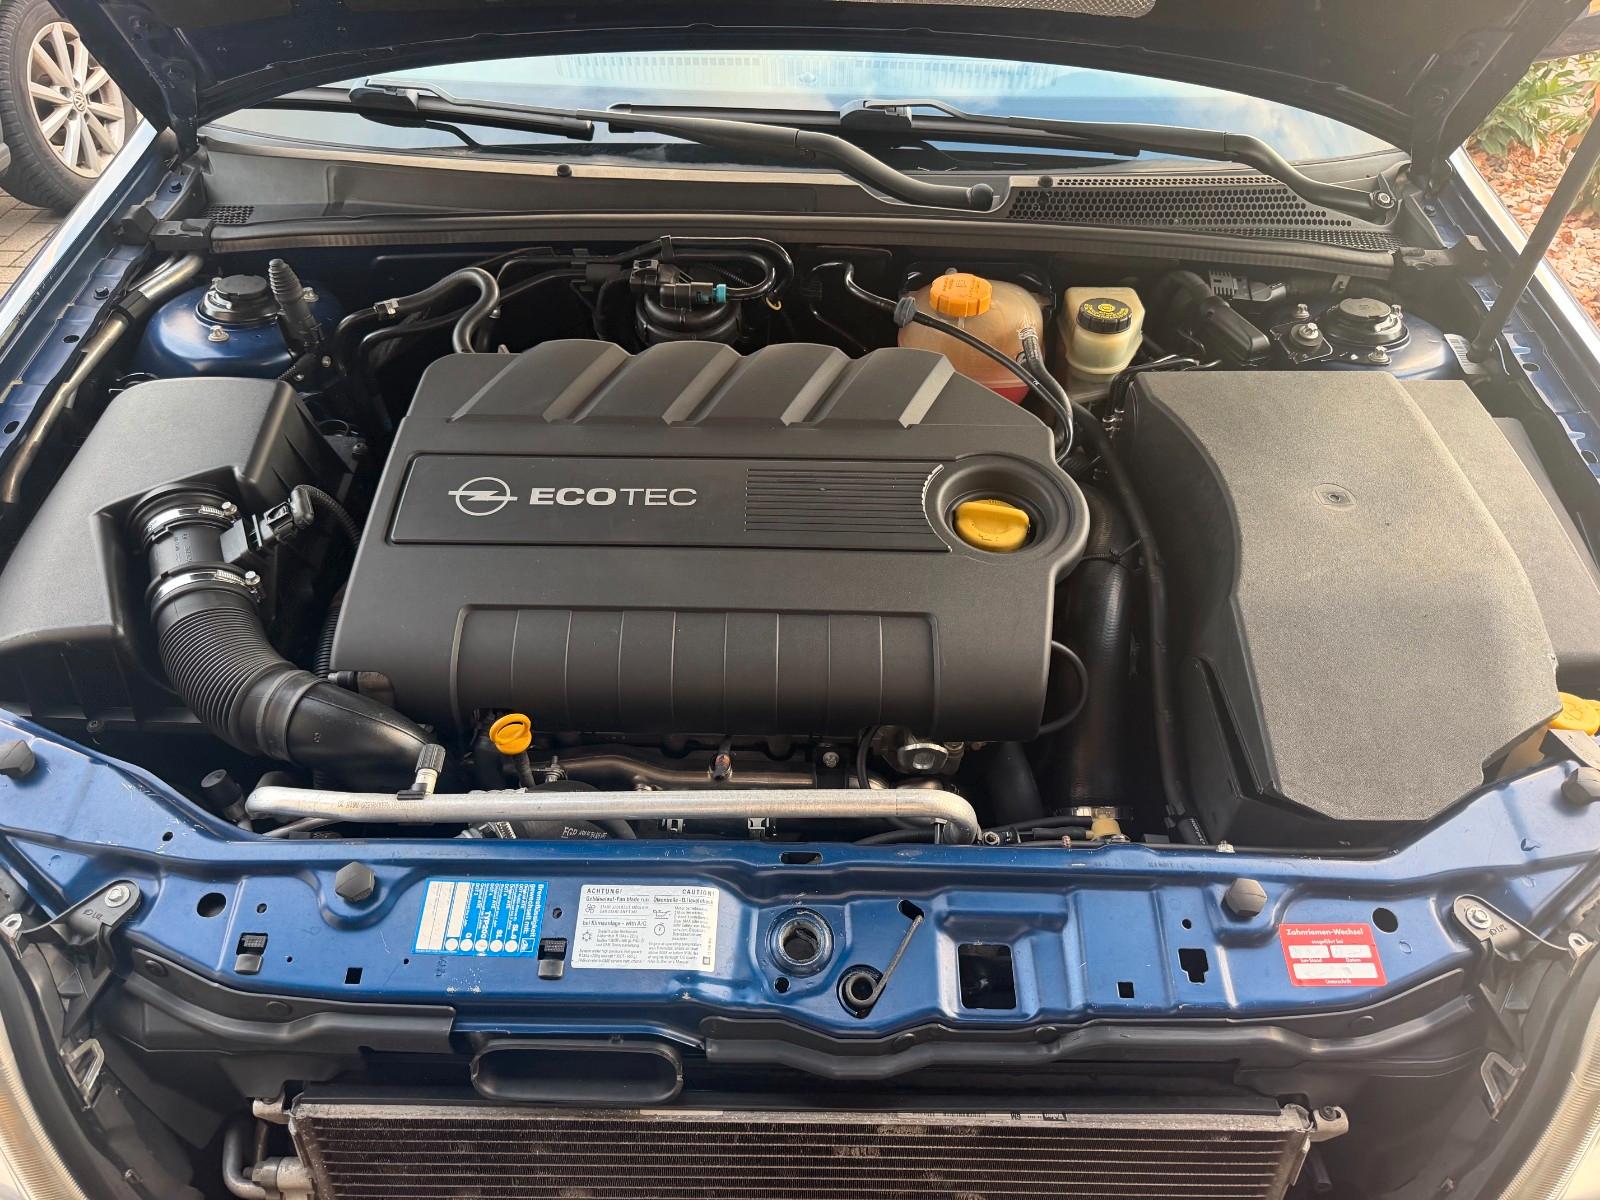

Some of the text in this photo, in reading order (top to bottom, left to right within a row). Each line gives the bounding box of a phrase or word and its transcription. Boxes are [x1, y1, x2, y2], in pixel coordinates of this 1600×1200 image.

[529, 487, 697, 506] ECOTEC
[682, 889, 715, 897] CAUTION!
[526, 884, 536, 920] gewechselt
[1286, 928, 1364, 936] Zahnriemen-Wechsel
